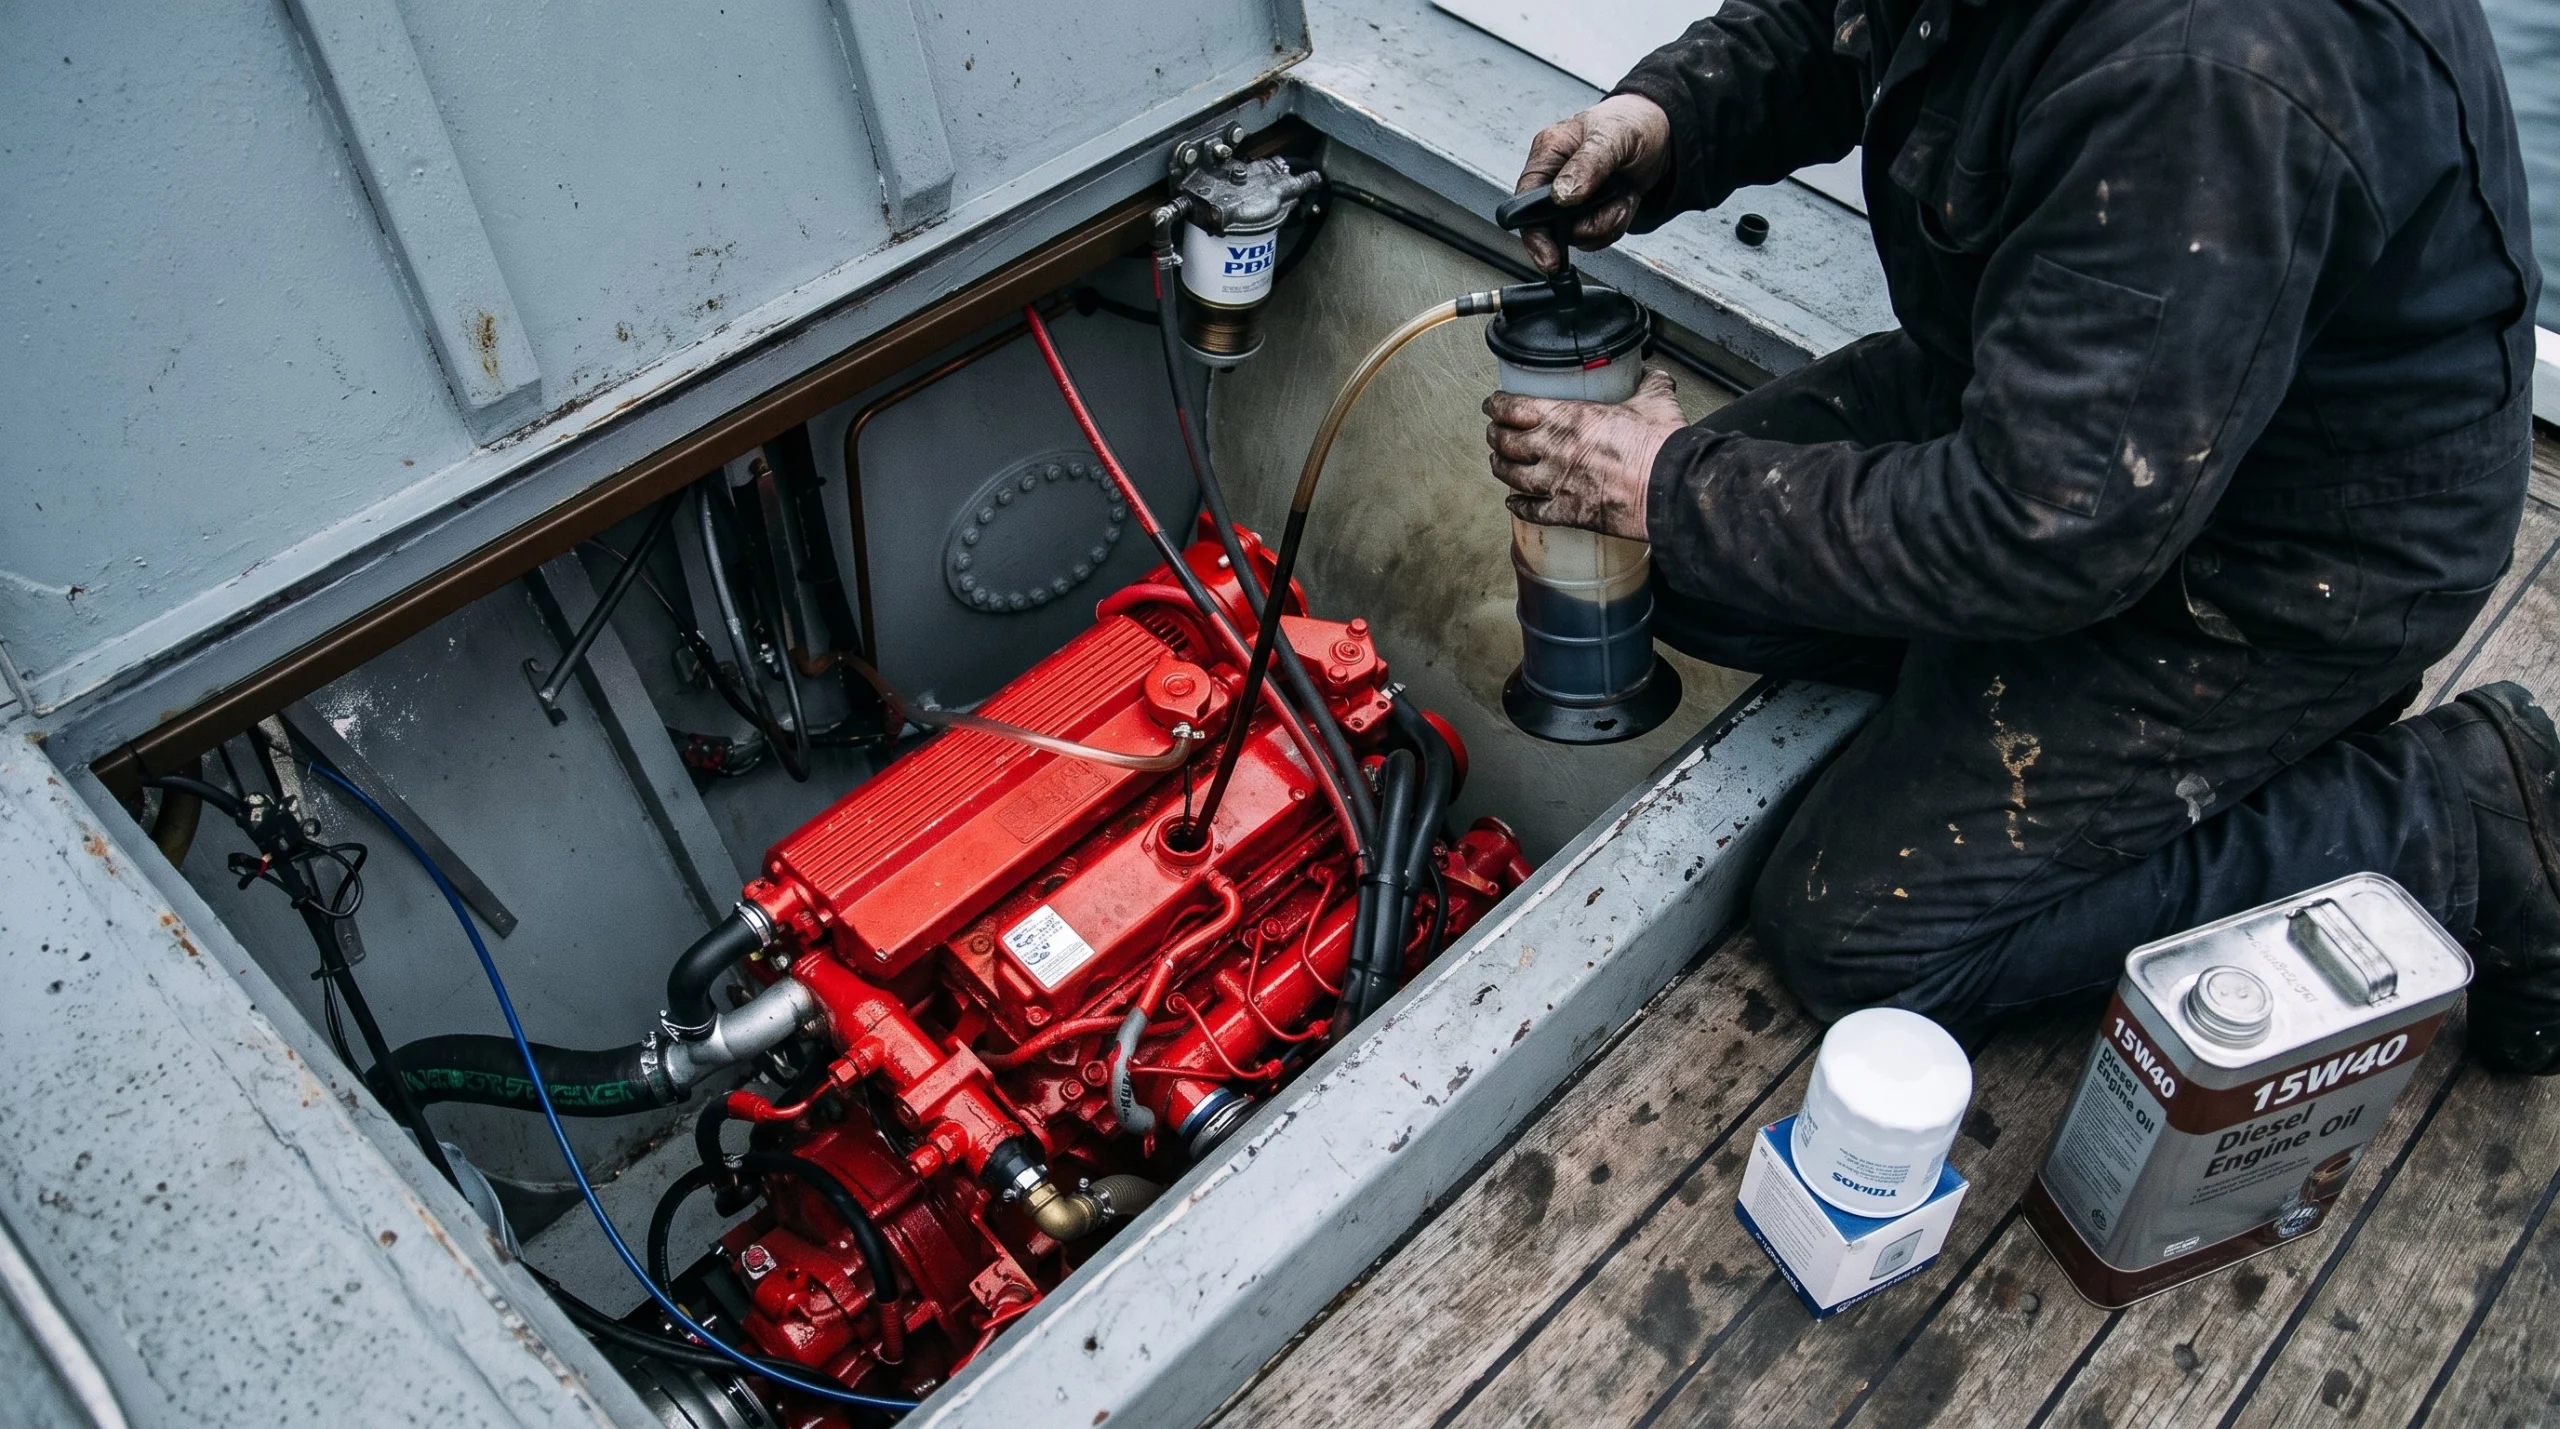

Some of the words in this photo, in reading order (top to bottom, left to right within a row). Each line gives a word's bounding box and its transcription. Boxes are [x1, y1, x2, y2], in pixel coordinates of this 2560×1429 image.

[2102, 1047, 2139, 1096] Diesel
[2114, 1017, 2176, 1099] 15W40
[2253, 1034, 2409, 1112] 15W40
[2097, 1061, 2134, 1112] Engine
[2136, 1109, 2155, 1134] Oil
[2215, 1103, 2316, 1155] Diesel
[2203, 1131, 2311, 1179] Engine
[2320, 1104, 2365, 1138] Oil
